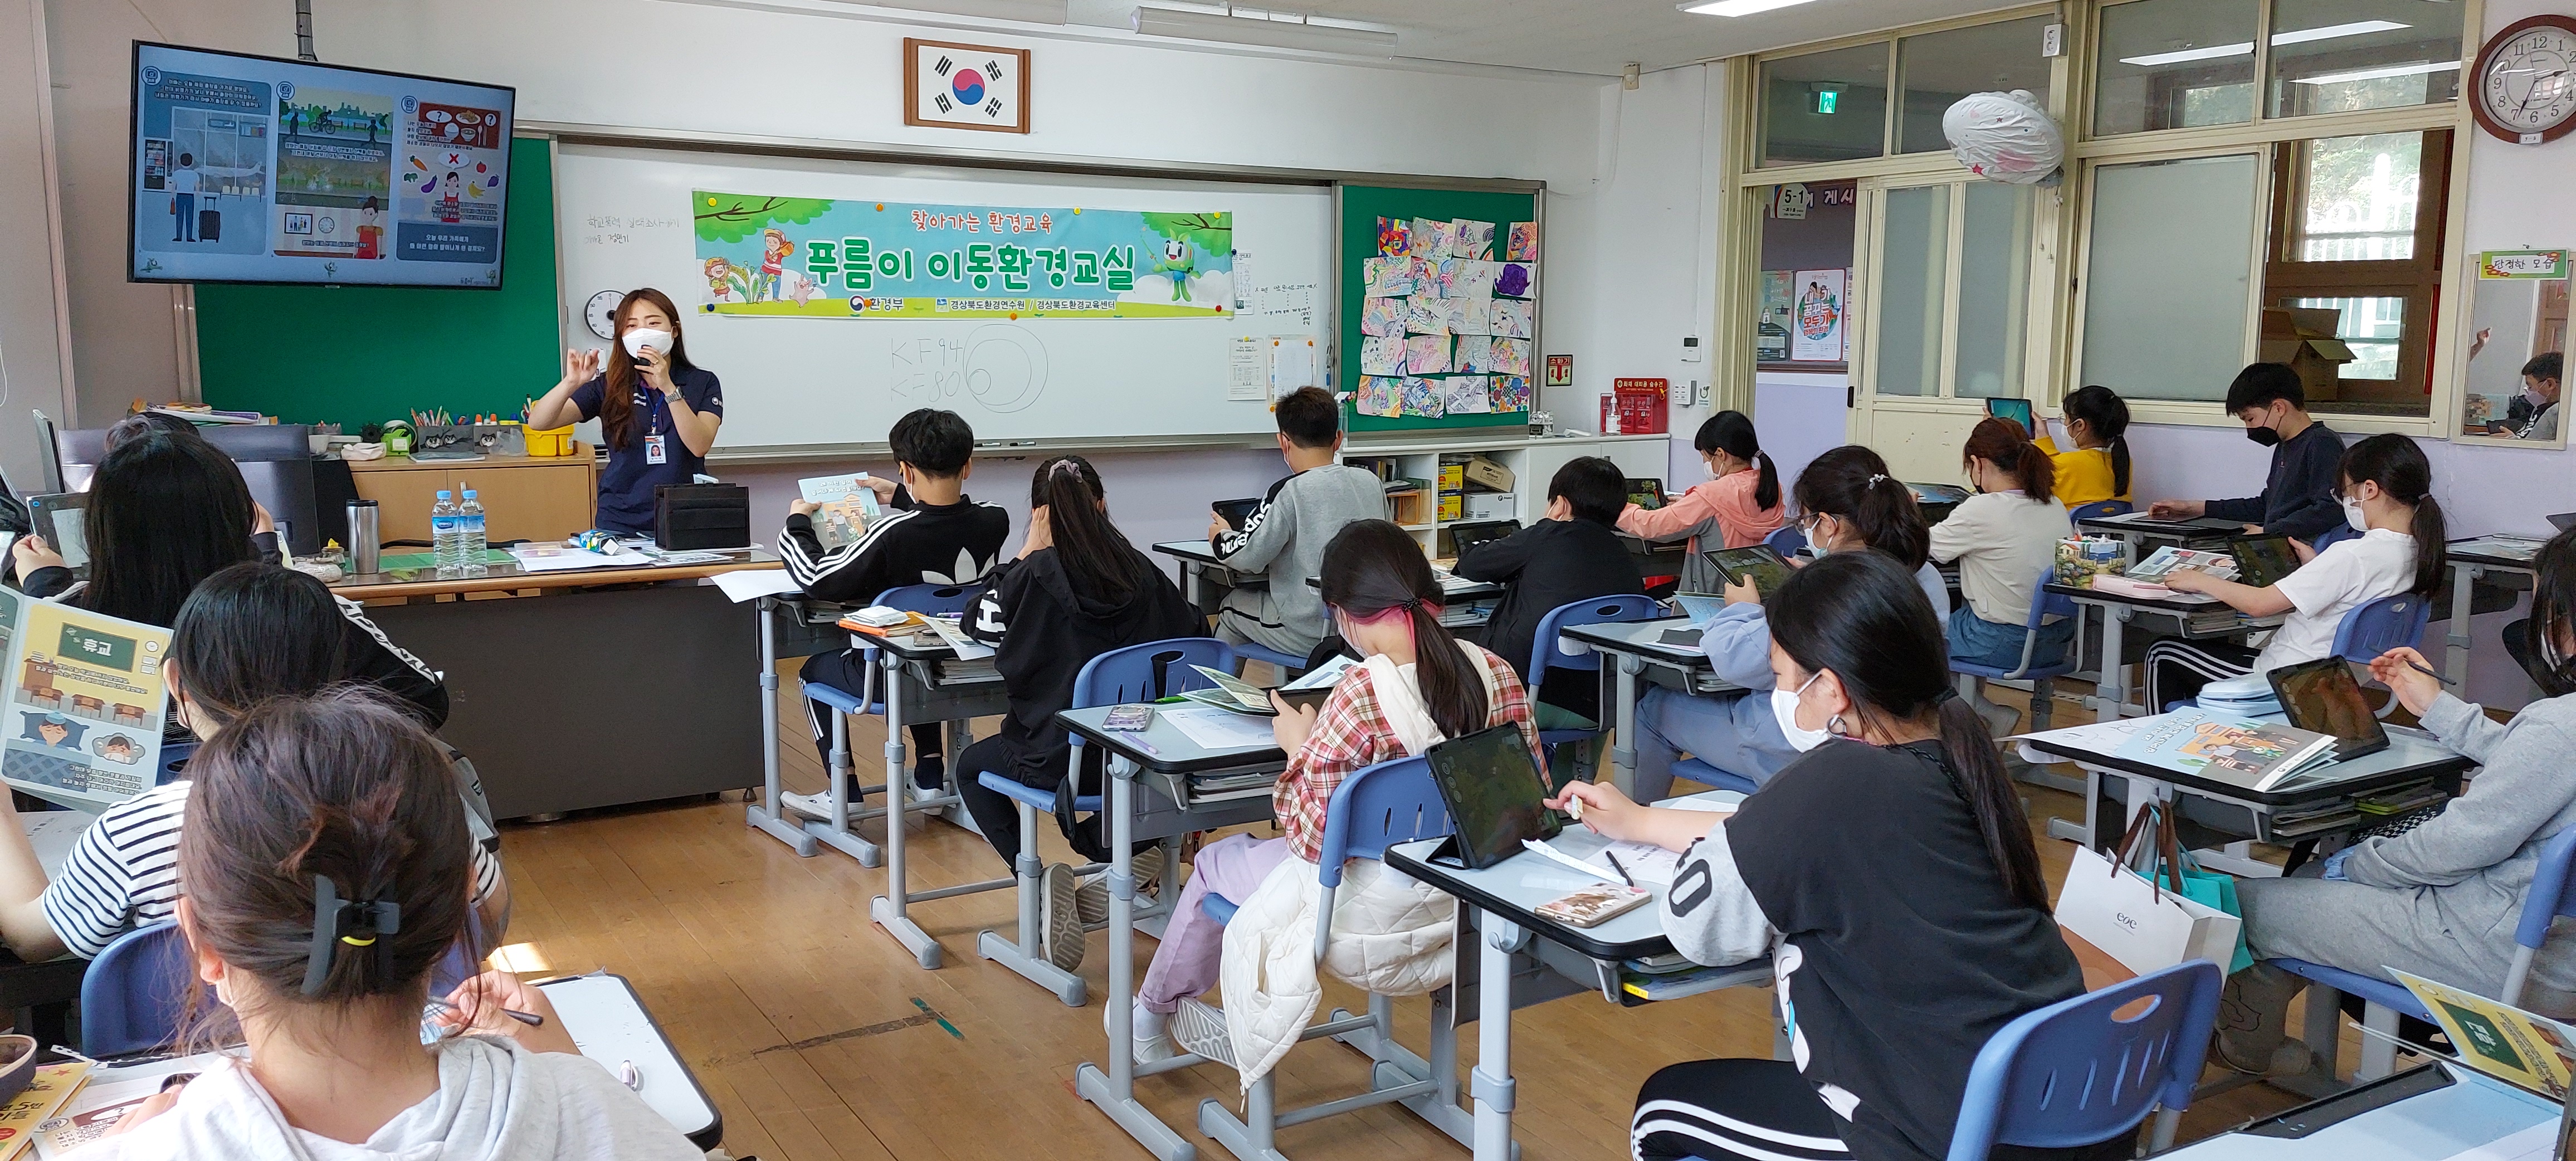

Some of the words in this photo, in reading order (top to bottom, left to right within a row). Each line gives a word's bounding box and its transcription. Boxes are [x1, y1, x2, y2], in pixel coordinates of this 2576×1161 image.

[2514, 43, 2525, 56] 11
[2531, 36, 2548, 50] 12
[2557, 39, 2564, 51] 1
[2494, 77, 2502, 89] 9
[2497, 95, 2506, 108] 8
[2565, 90, 2574, 101] 4
[2510, 109, 2519, 121] 7
[2530, 111, 2538, 123] 6
[2550, 105, 2559, 117] 5
[1784, 189, 1804, 204] 5-1
[911, 210, 980, 232] 찾아가는
[989, 212, 1052, 233] 환경교육
[808, 238, 912, 289] 푸름이
[928, 244, 1134, 292] 이동환경교실
[2494, 258, 2526, 270] 단정한
[2533, 258, 2553, 270] 모습
[870, 297, 904, 311] 환경부
[950, 300, 1025, 310] 경상북도환경연수원
[1037, 300, 1116, 311] 경상북도환경교육센터
[1804, 303, 1831, 316] 꿈꾸는
[1803, 313, 1829, 329] 모두가
[82, 637, 112, 657] 휴교
[2117, 912, 2137, 929] eoe
